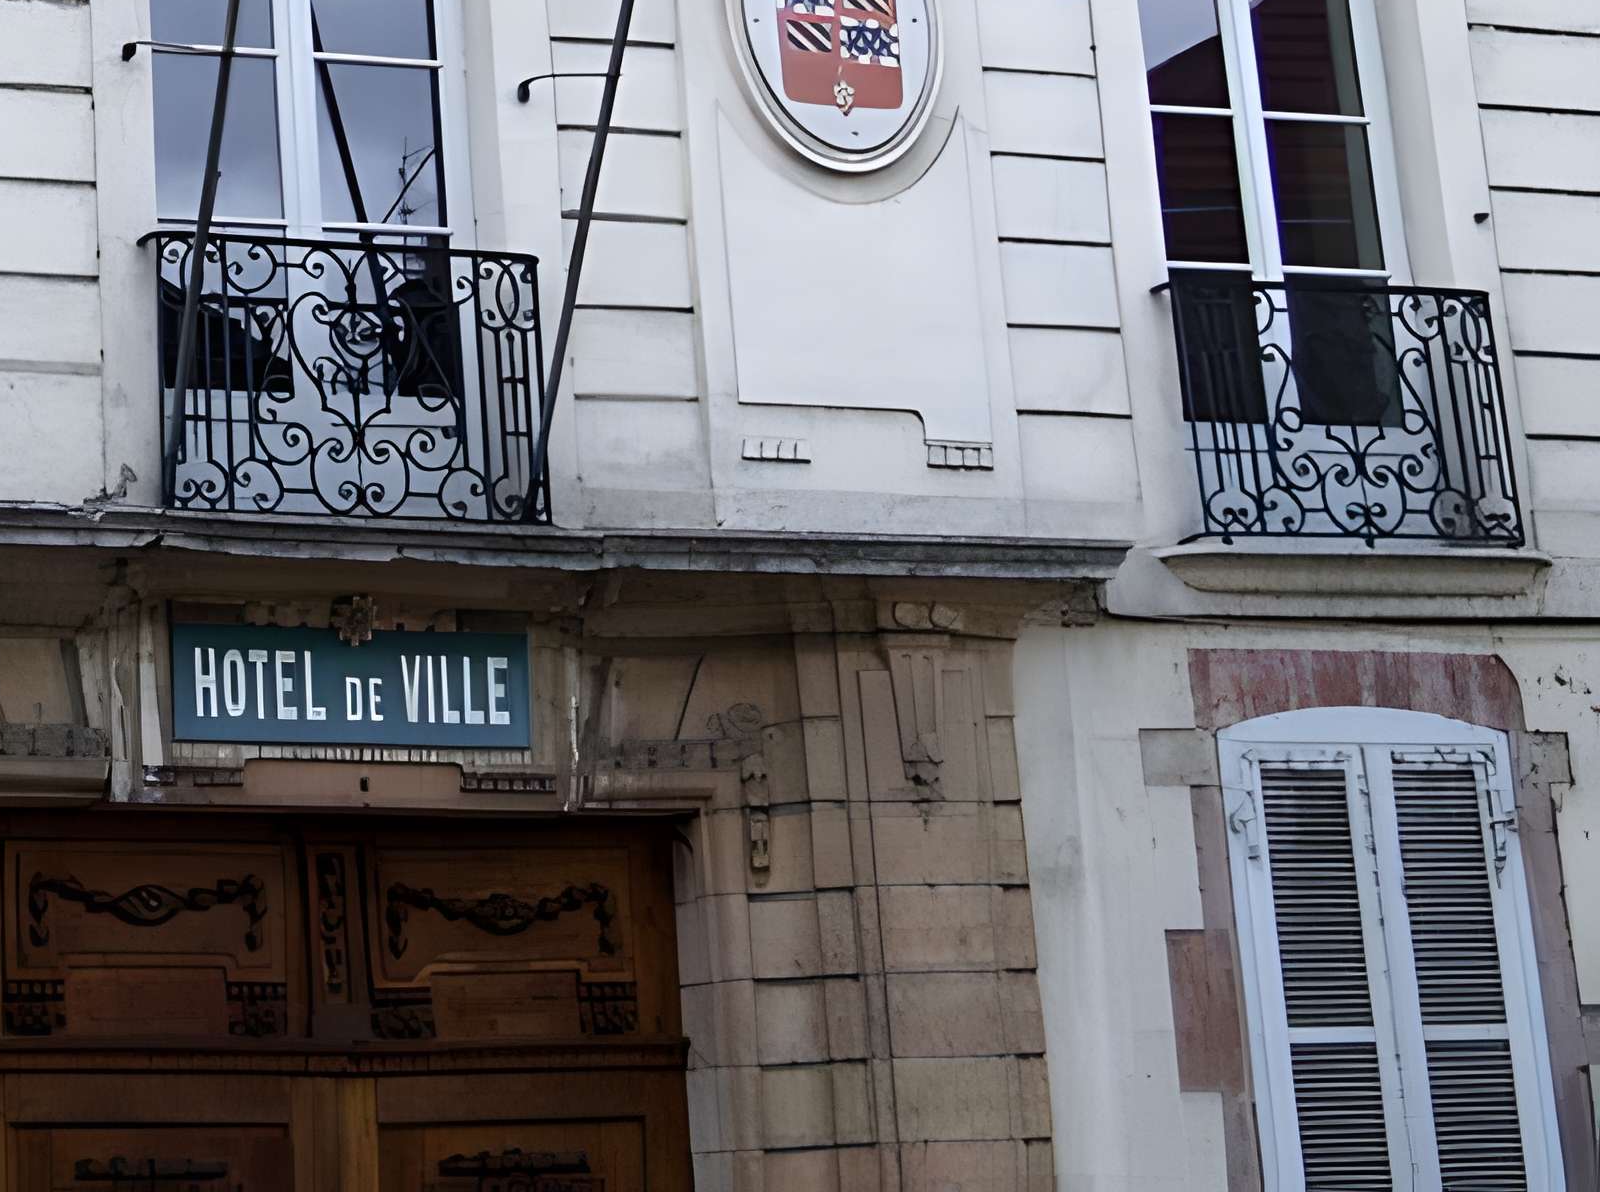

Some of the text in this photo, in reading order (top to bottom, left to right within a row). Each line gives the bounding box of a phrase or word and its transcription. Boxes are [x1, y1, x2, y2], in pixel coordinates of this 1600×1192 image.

[193, 646, 512, 726] HOTEL DE VILLE
